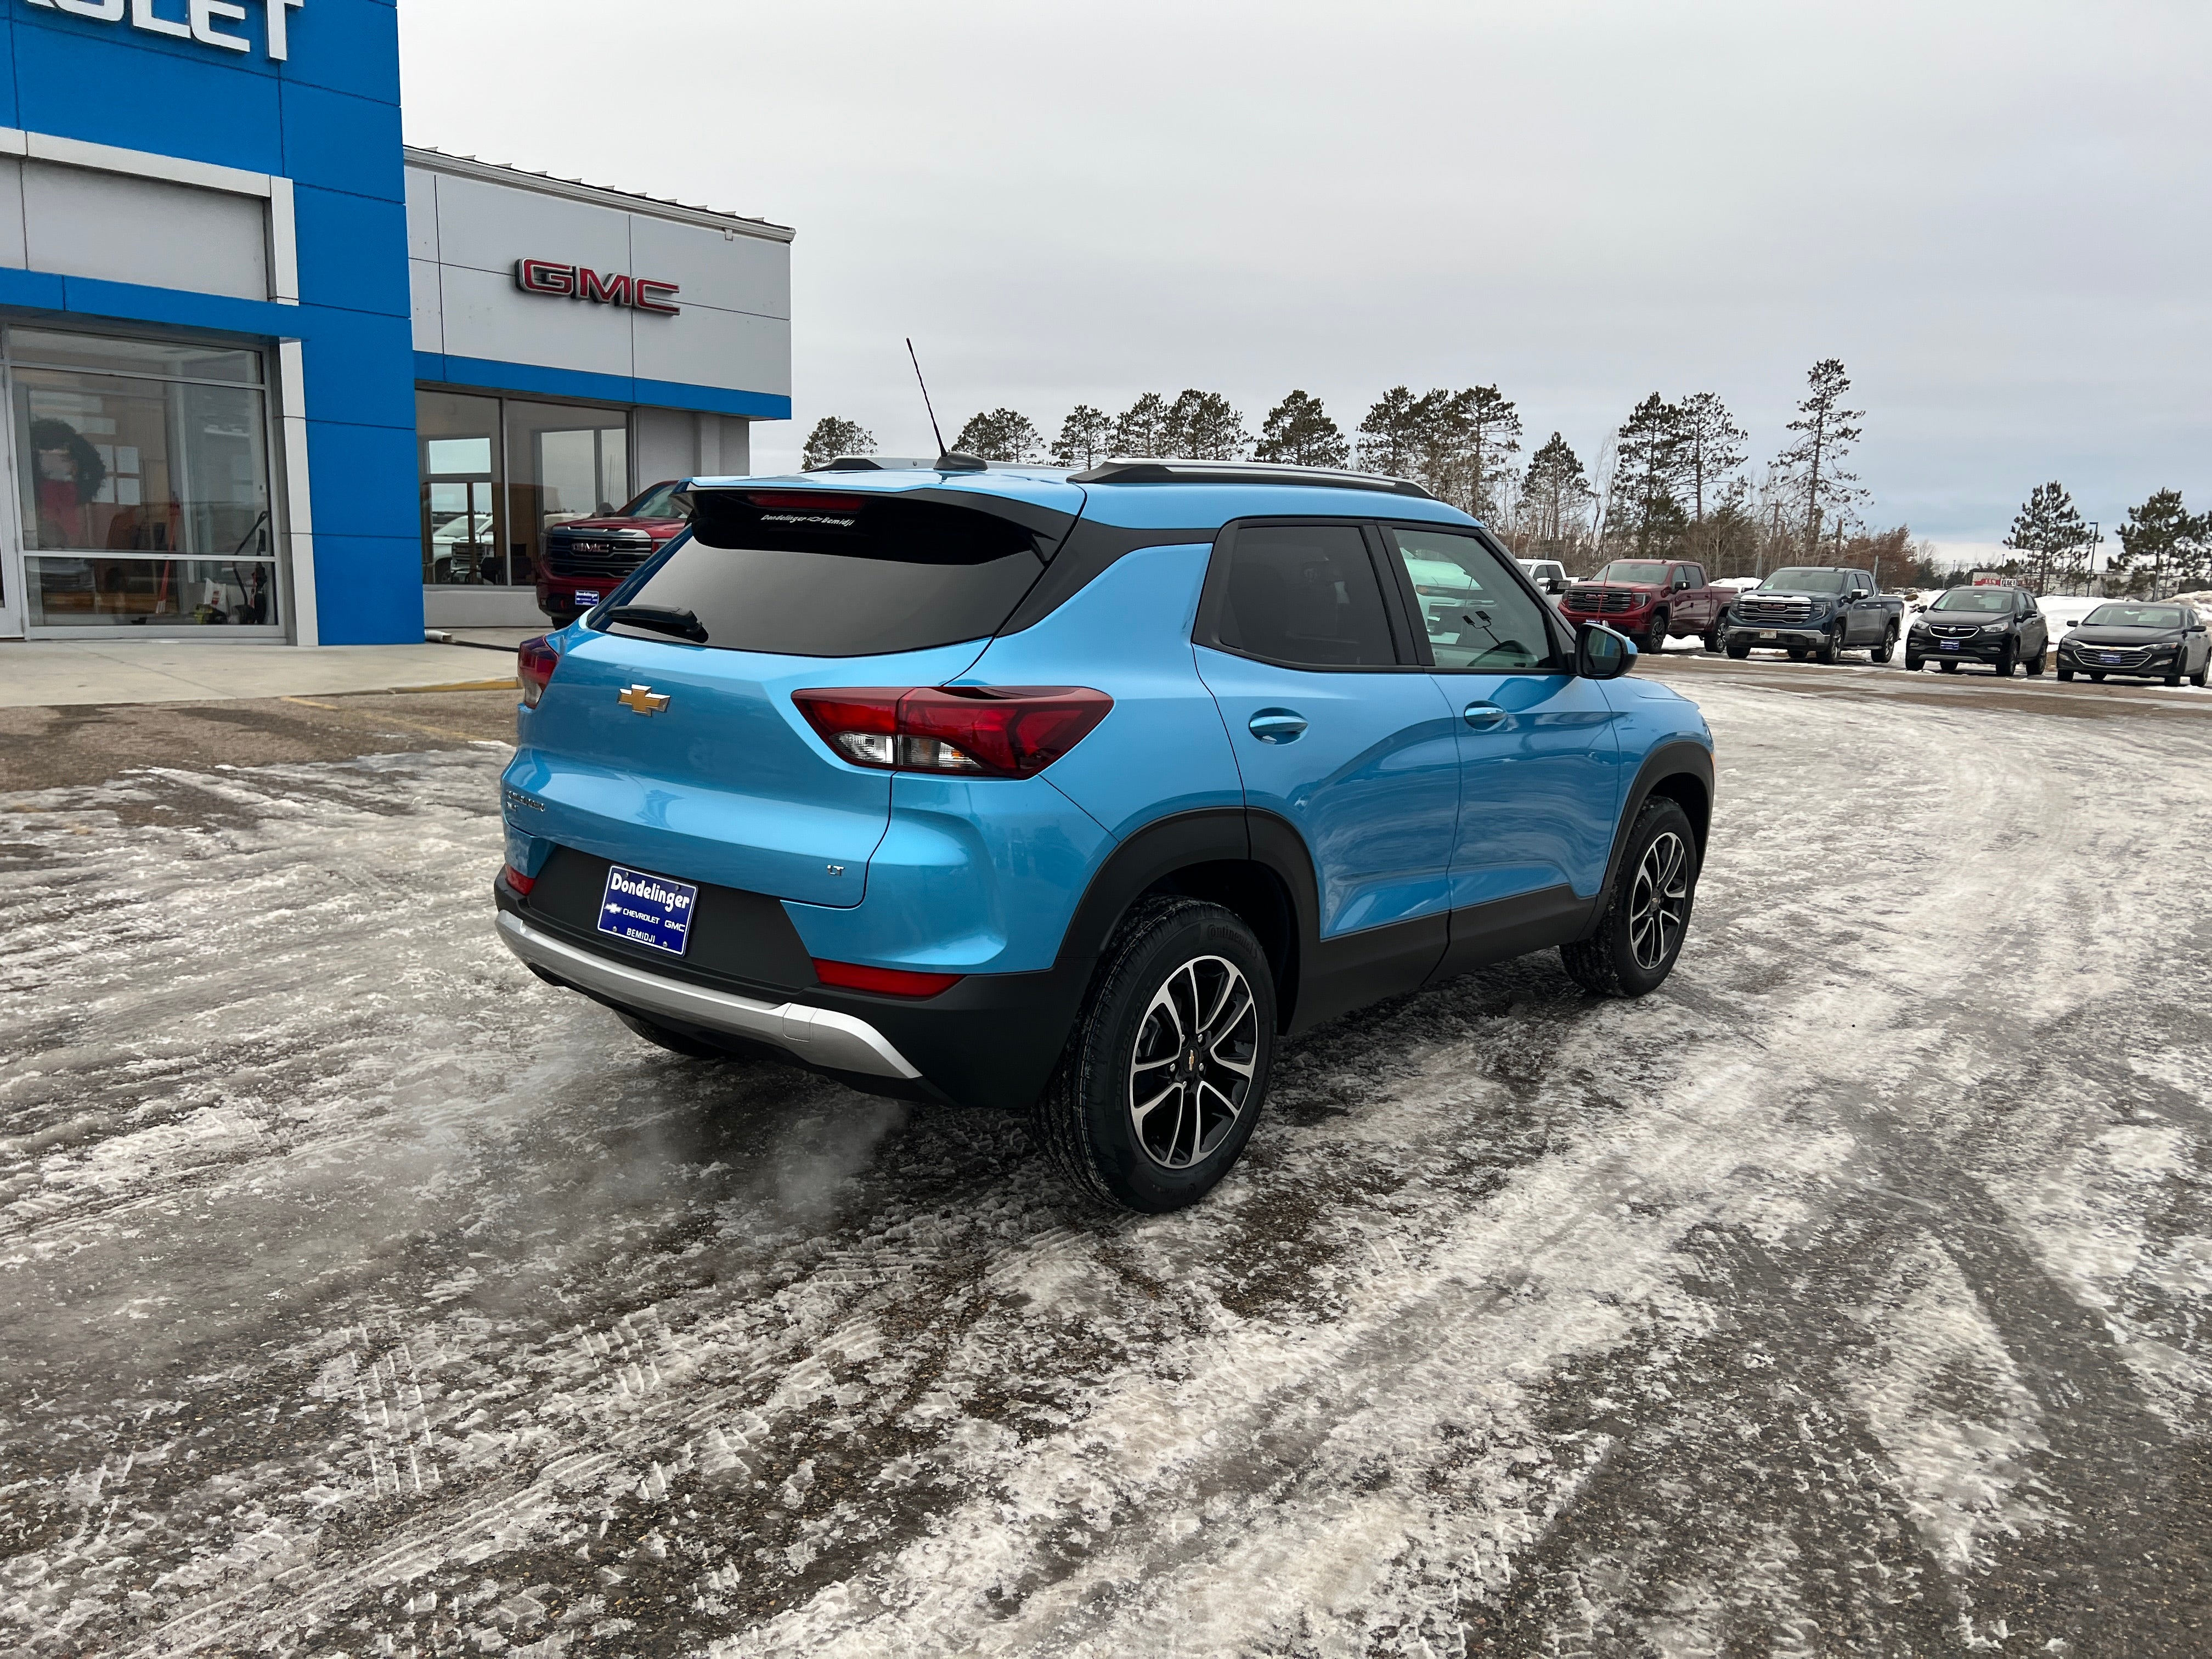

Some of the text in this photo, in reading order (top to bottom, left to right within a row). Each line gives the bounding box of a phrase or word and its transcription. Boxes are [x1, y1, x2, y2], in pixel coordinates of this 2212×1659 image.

[515, 258, 680, 315] GMC
[761, 515, 855, 527] Dondelinger Bemidji
[611, 872, 690, 912] Dondelinger
[623, 908, 685, 932] CHEVROLET GMC
[627, 928, 655, 943] BEMIDJI
[1206, 924, 1254, 955] Continental
